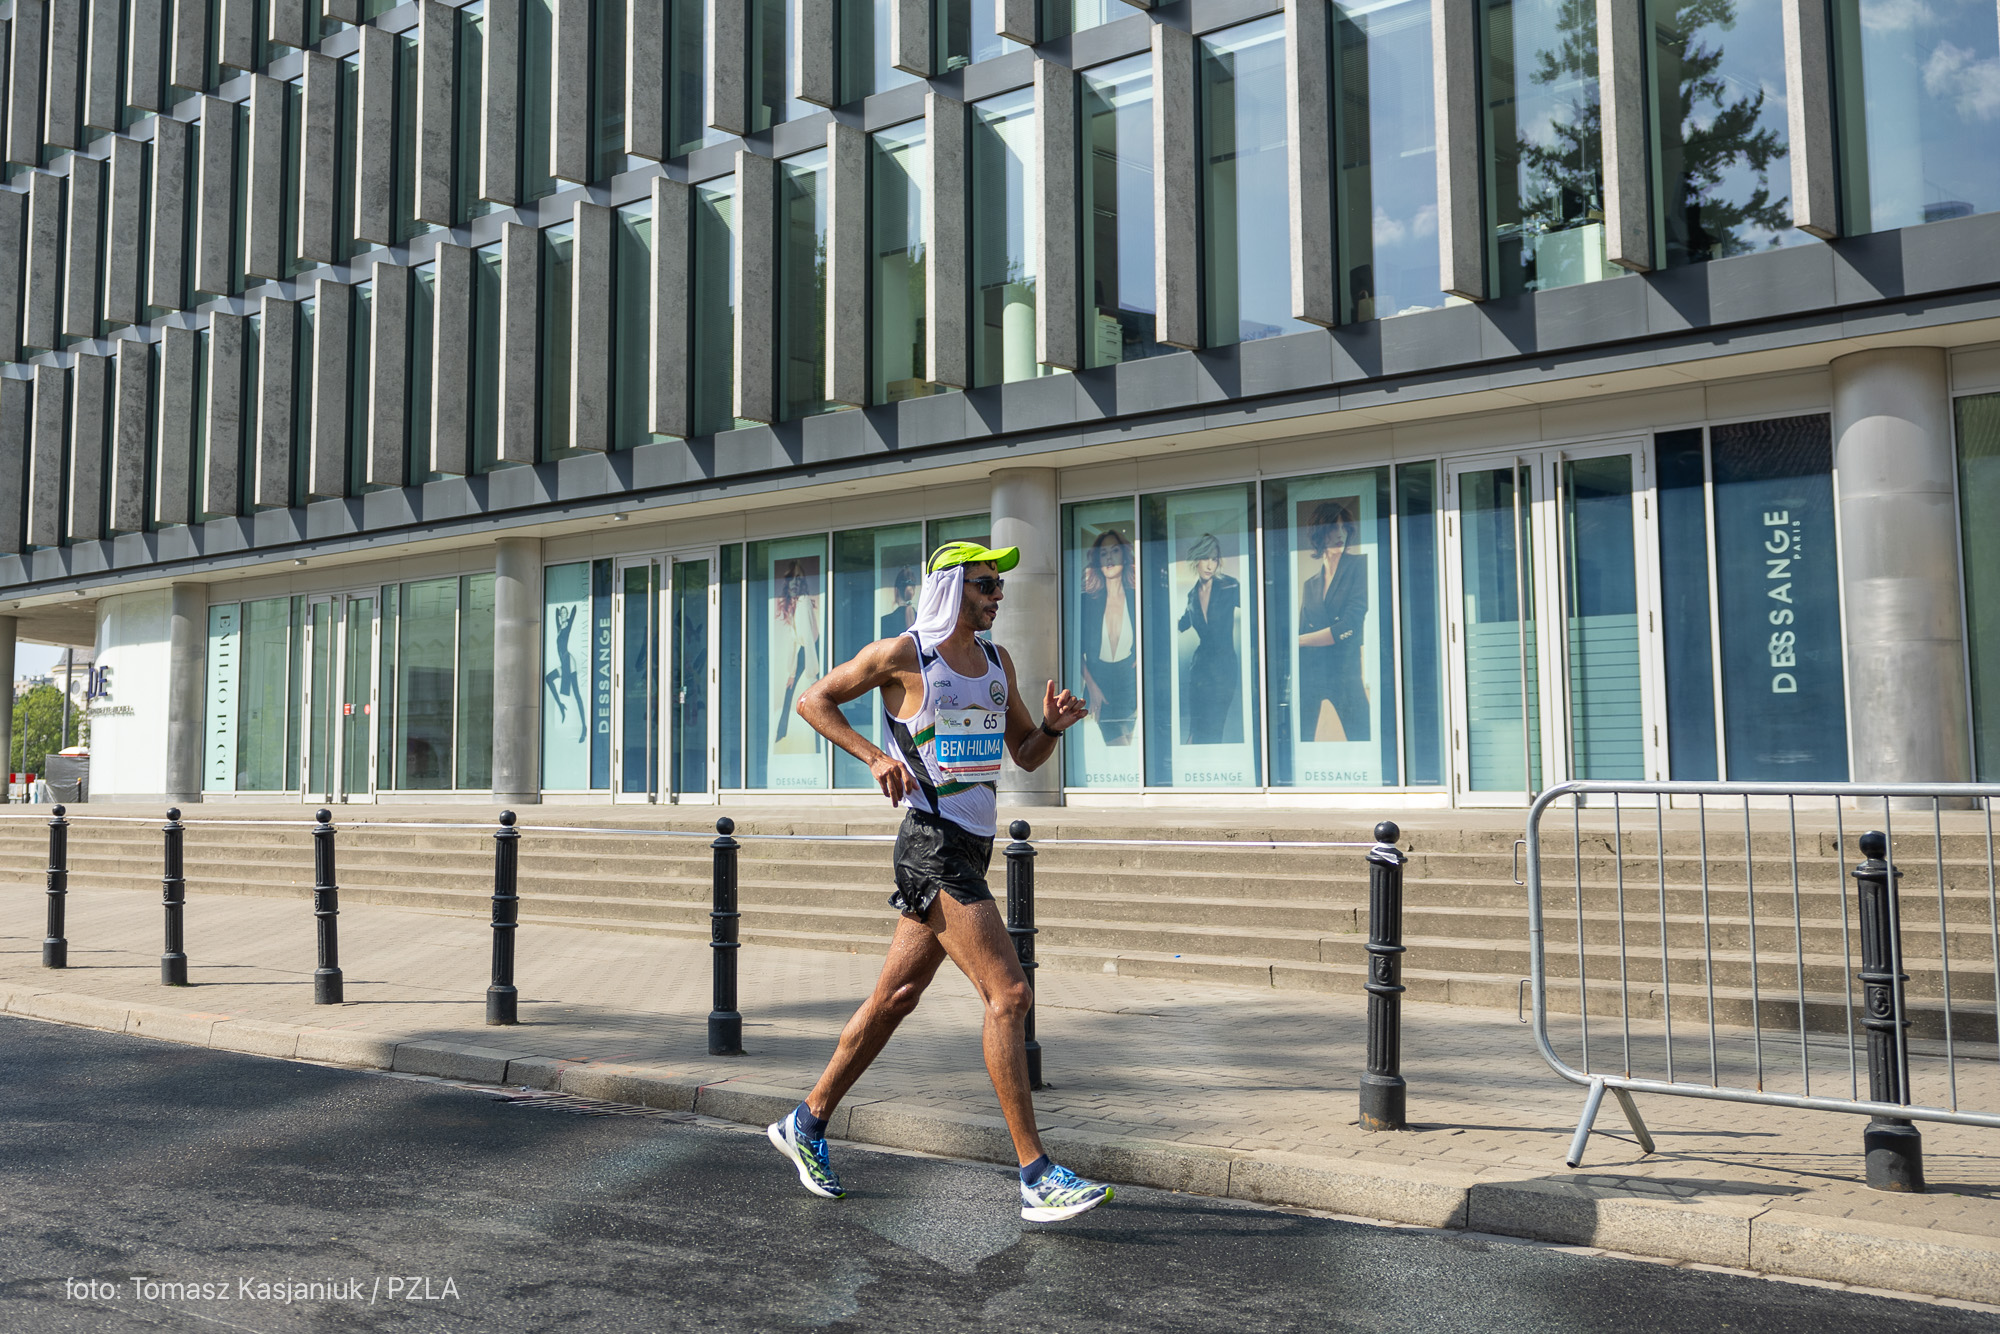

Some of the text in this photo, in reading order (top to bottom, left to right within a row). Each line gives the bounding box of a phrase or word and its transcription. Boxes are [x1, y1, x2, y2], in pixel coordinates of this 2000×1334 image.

[1792, 520, 1802, 560] PARIS
[1764, 510, 1798, 694] DESSANGE
[598, 617, 611, 734] DESSANGE
[215, 615, 231, 781] EMILIO PUCCI
[983, 713, 998, 730] 65
[941, 739, 1001, 757] BEN HILIMA
[776, 777, 818, 786] DESSANGE
[1085, 773, 1139, 783] DESSANGE
[1184, 772, 1243, 782] DESSANGE
[1305, 771, 1369, 781] DESSANGE
